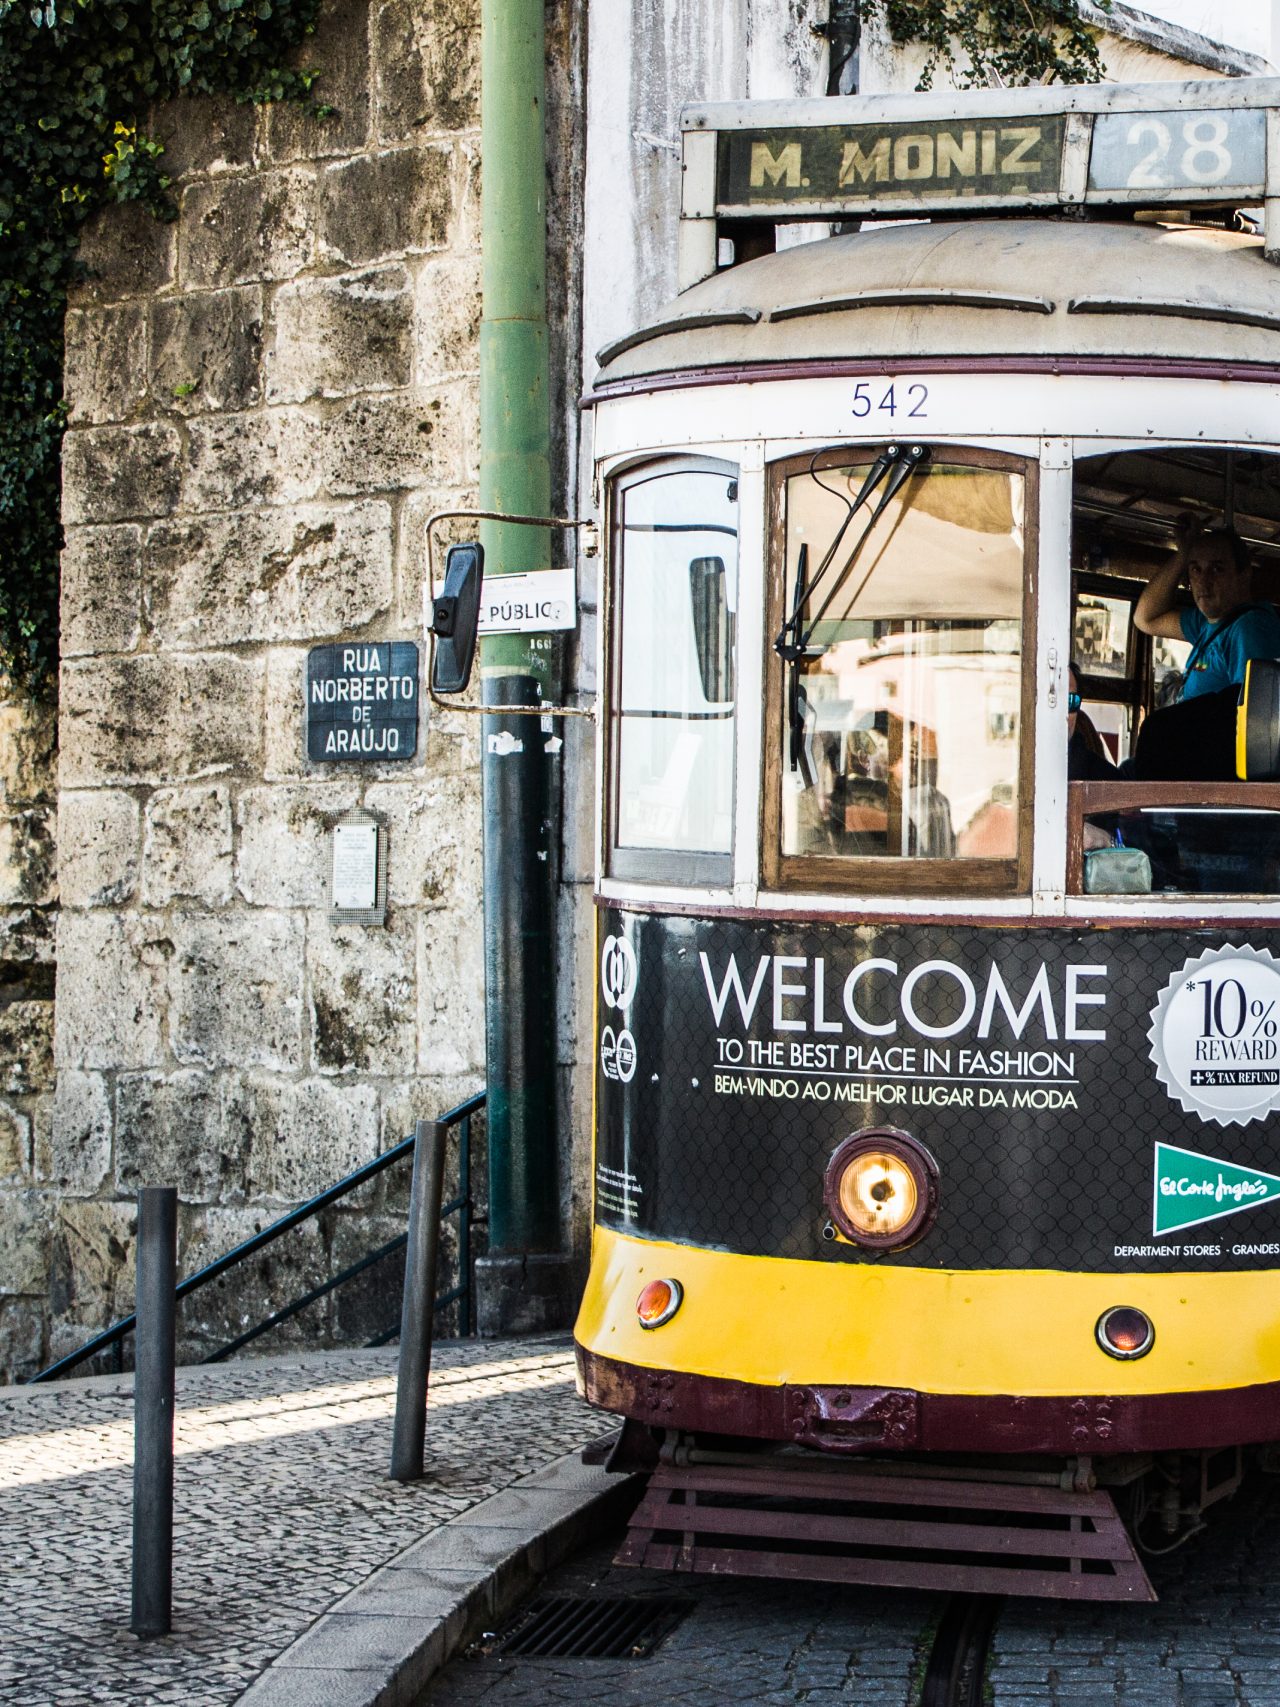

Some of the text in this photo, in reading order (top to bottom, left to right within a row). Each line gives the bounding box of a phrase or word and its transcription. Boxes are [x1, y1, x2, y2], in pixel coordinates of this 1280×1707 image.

[749, 126, 1042, 187] M. MONIZ
[1125, 116, 1233, 188] 28
[852, 383, 928, 417] 542
[490, 600, 560, 623] PÚBLIC
[343, 648, 381, 672] RUA
[312, 675, 414, 703] NORBERTO
[352, 706, 372, 723] DE
[325, 723, 399, 753] ARAÚJO
[699, 952, 1107, 1040] WELCOME
[716, 1038, 1075, 1076] TO THE BEST PLACE IN FASHION
[1195, 1039, 1278, 1061] REWARD
[1217, 1072, 1236, 1084] TAX
[1238, 1071, 1278, 1084] REFUND
[714, 1075, 1078, 1109] BEM-VINDO AO MELHOR LUGAR DA MODA
[1159, 1176, 1177, 1196] El
[1177, 1178, 1214, 1196] Corte
[1114, 1246, 1181, 1257] DEPARTMENT
[1183, 1245, 1221, 1256] STORES
[1232, 1243, 1280, 1255] GRANDES
